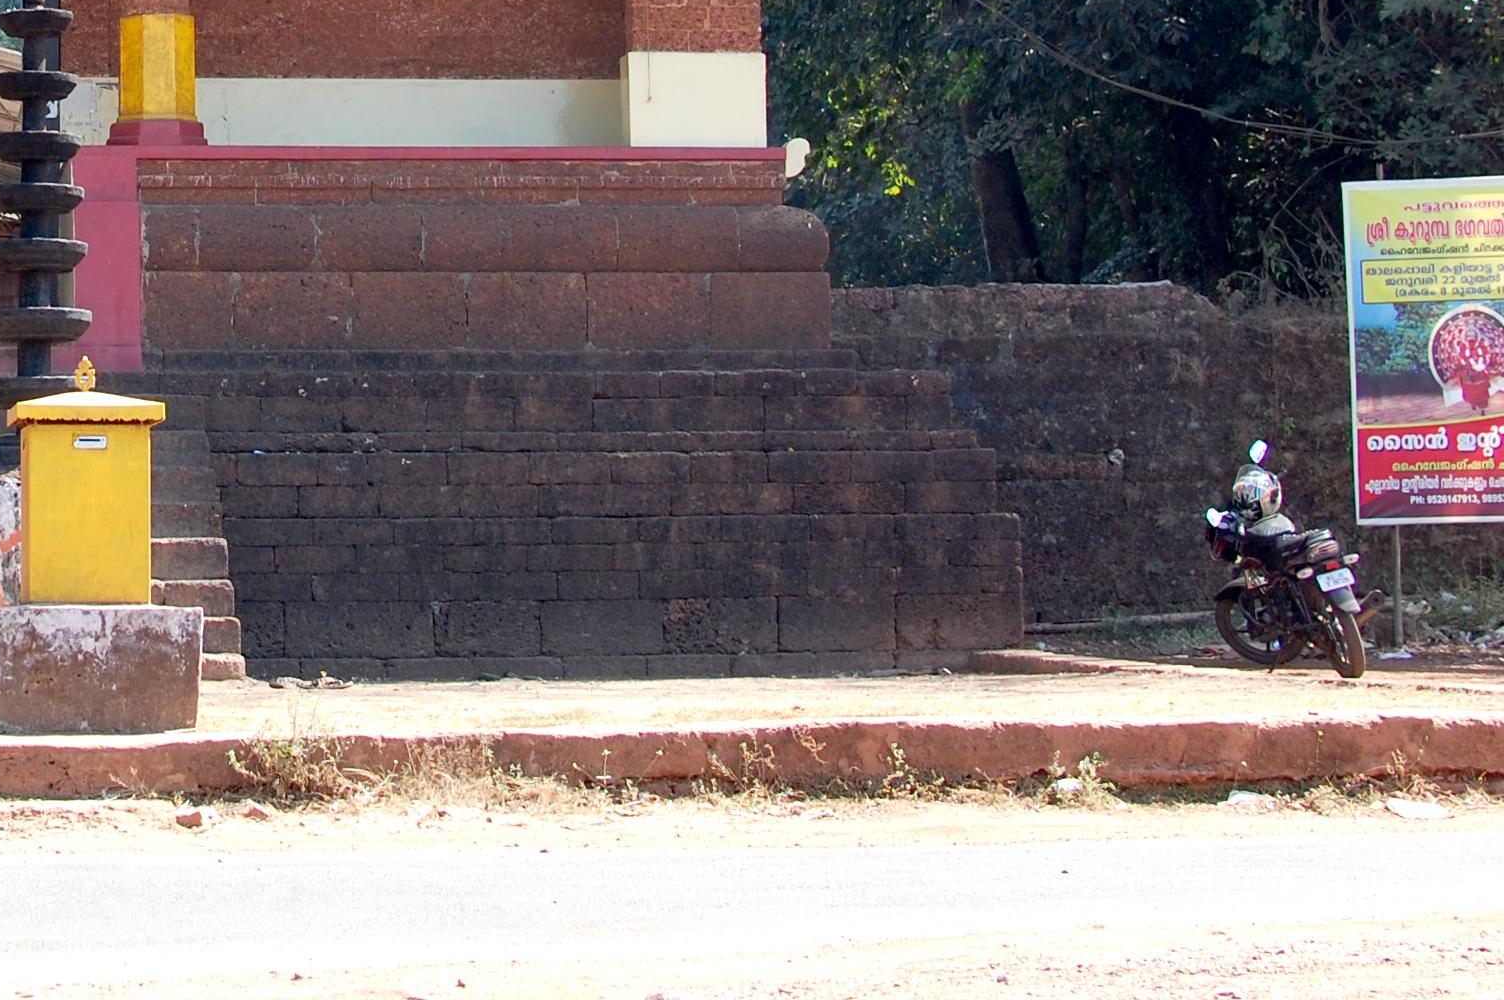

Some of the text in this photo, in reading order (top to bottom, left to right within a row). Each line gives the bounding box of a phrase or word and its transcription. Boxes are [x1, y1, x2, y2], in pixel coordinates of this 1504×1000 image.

[1366, 216, 1390, 247] ശ്രീ
[1394, 220, 1450, 245] കുറുമ്പ
[1385, 274, 1501, 287] ജനുവരി 22 മുതൽ
[1451, 285, 1491, 297] മുതൽ
[1367, 427, 1449, 451] സൈൻ
